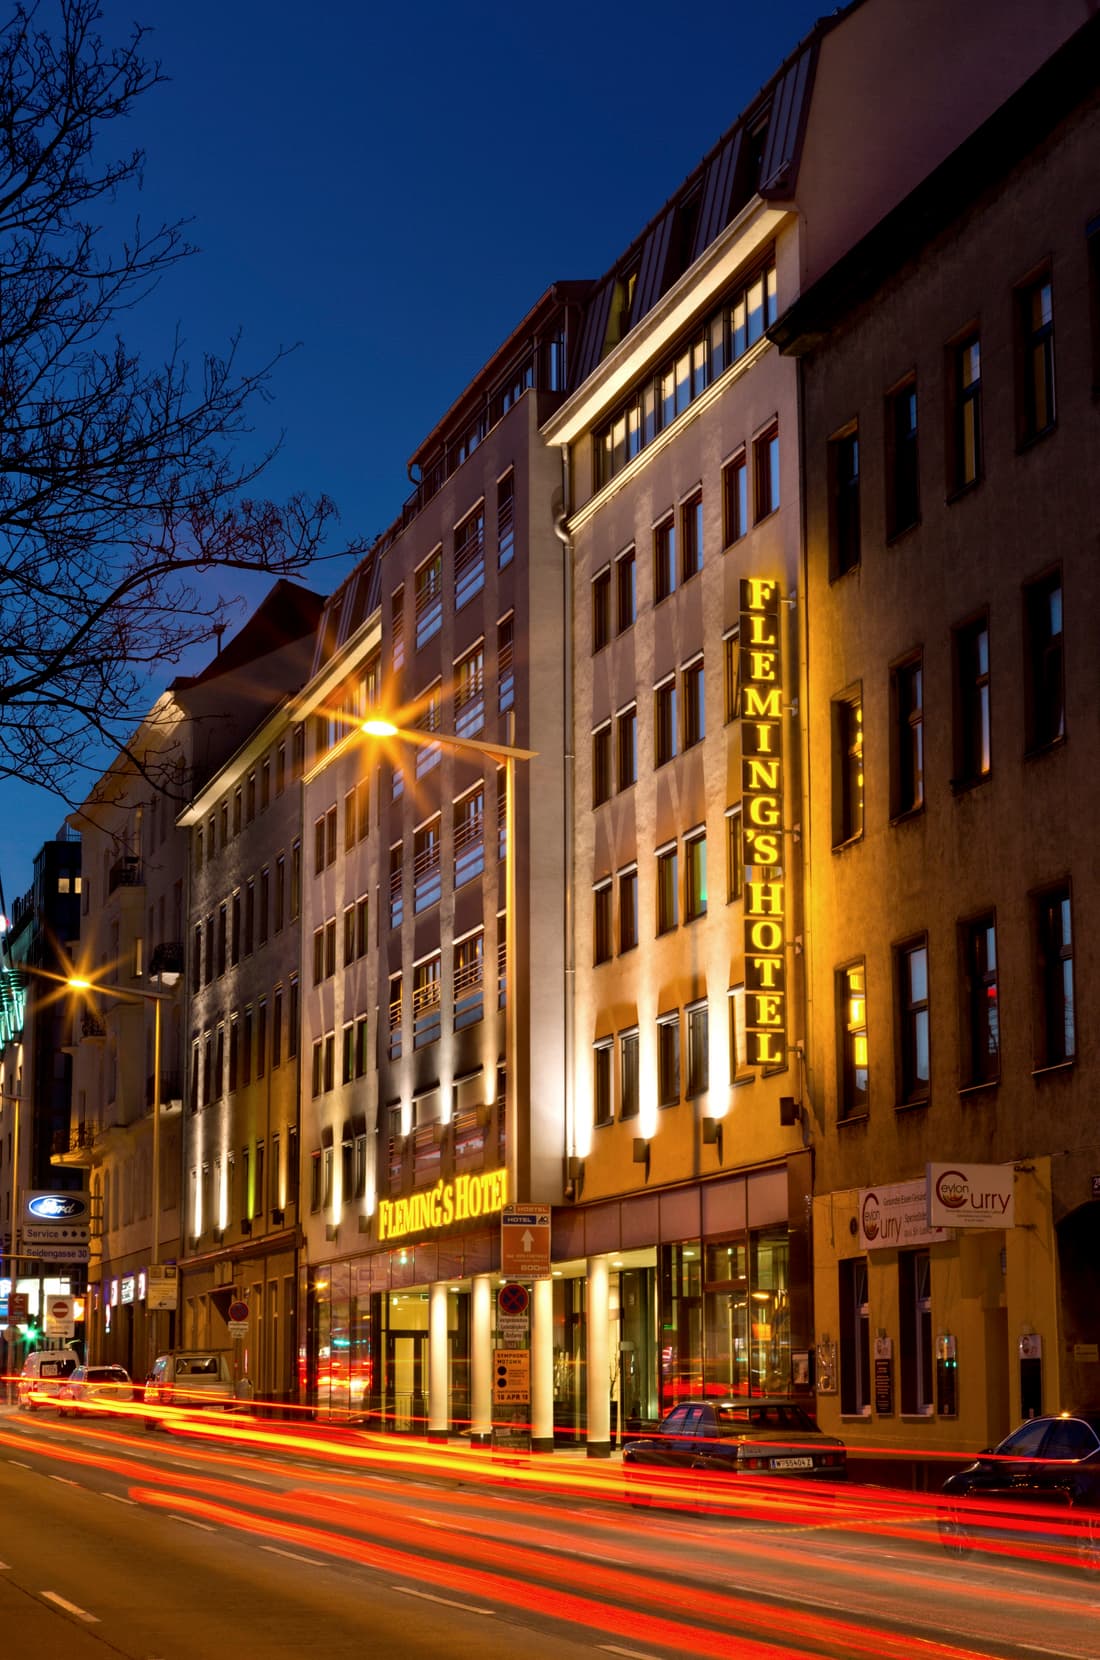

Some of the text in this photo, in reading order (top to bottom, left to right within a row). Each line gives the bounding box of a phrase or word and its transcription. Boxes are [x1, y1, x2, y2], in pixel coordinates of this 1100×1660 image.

[744, 578, 784, 1064] FLEMING'S HOTEL
[27, 1229, 59, 1237] Service
[379, 1178, 453, 1240] FLEMING'S
